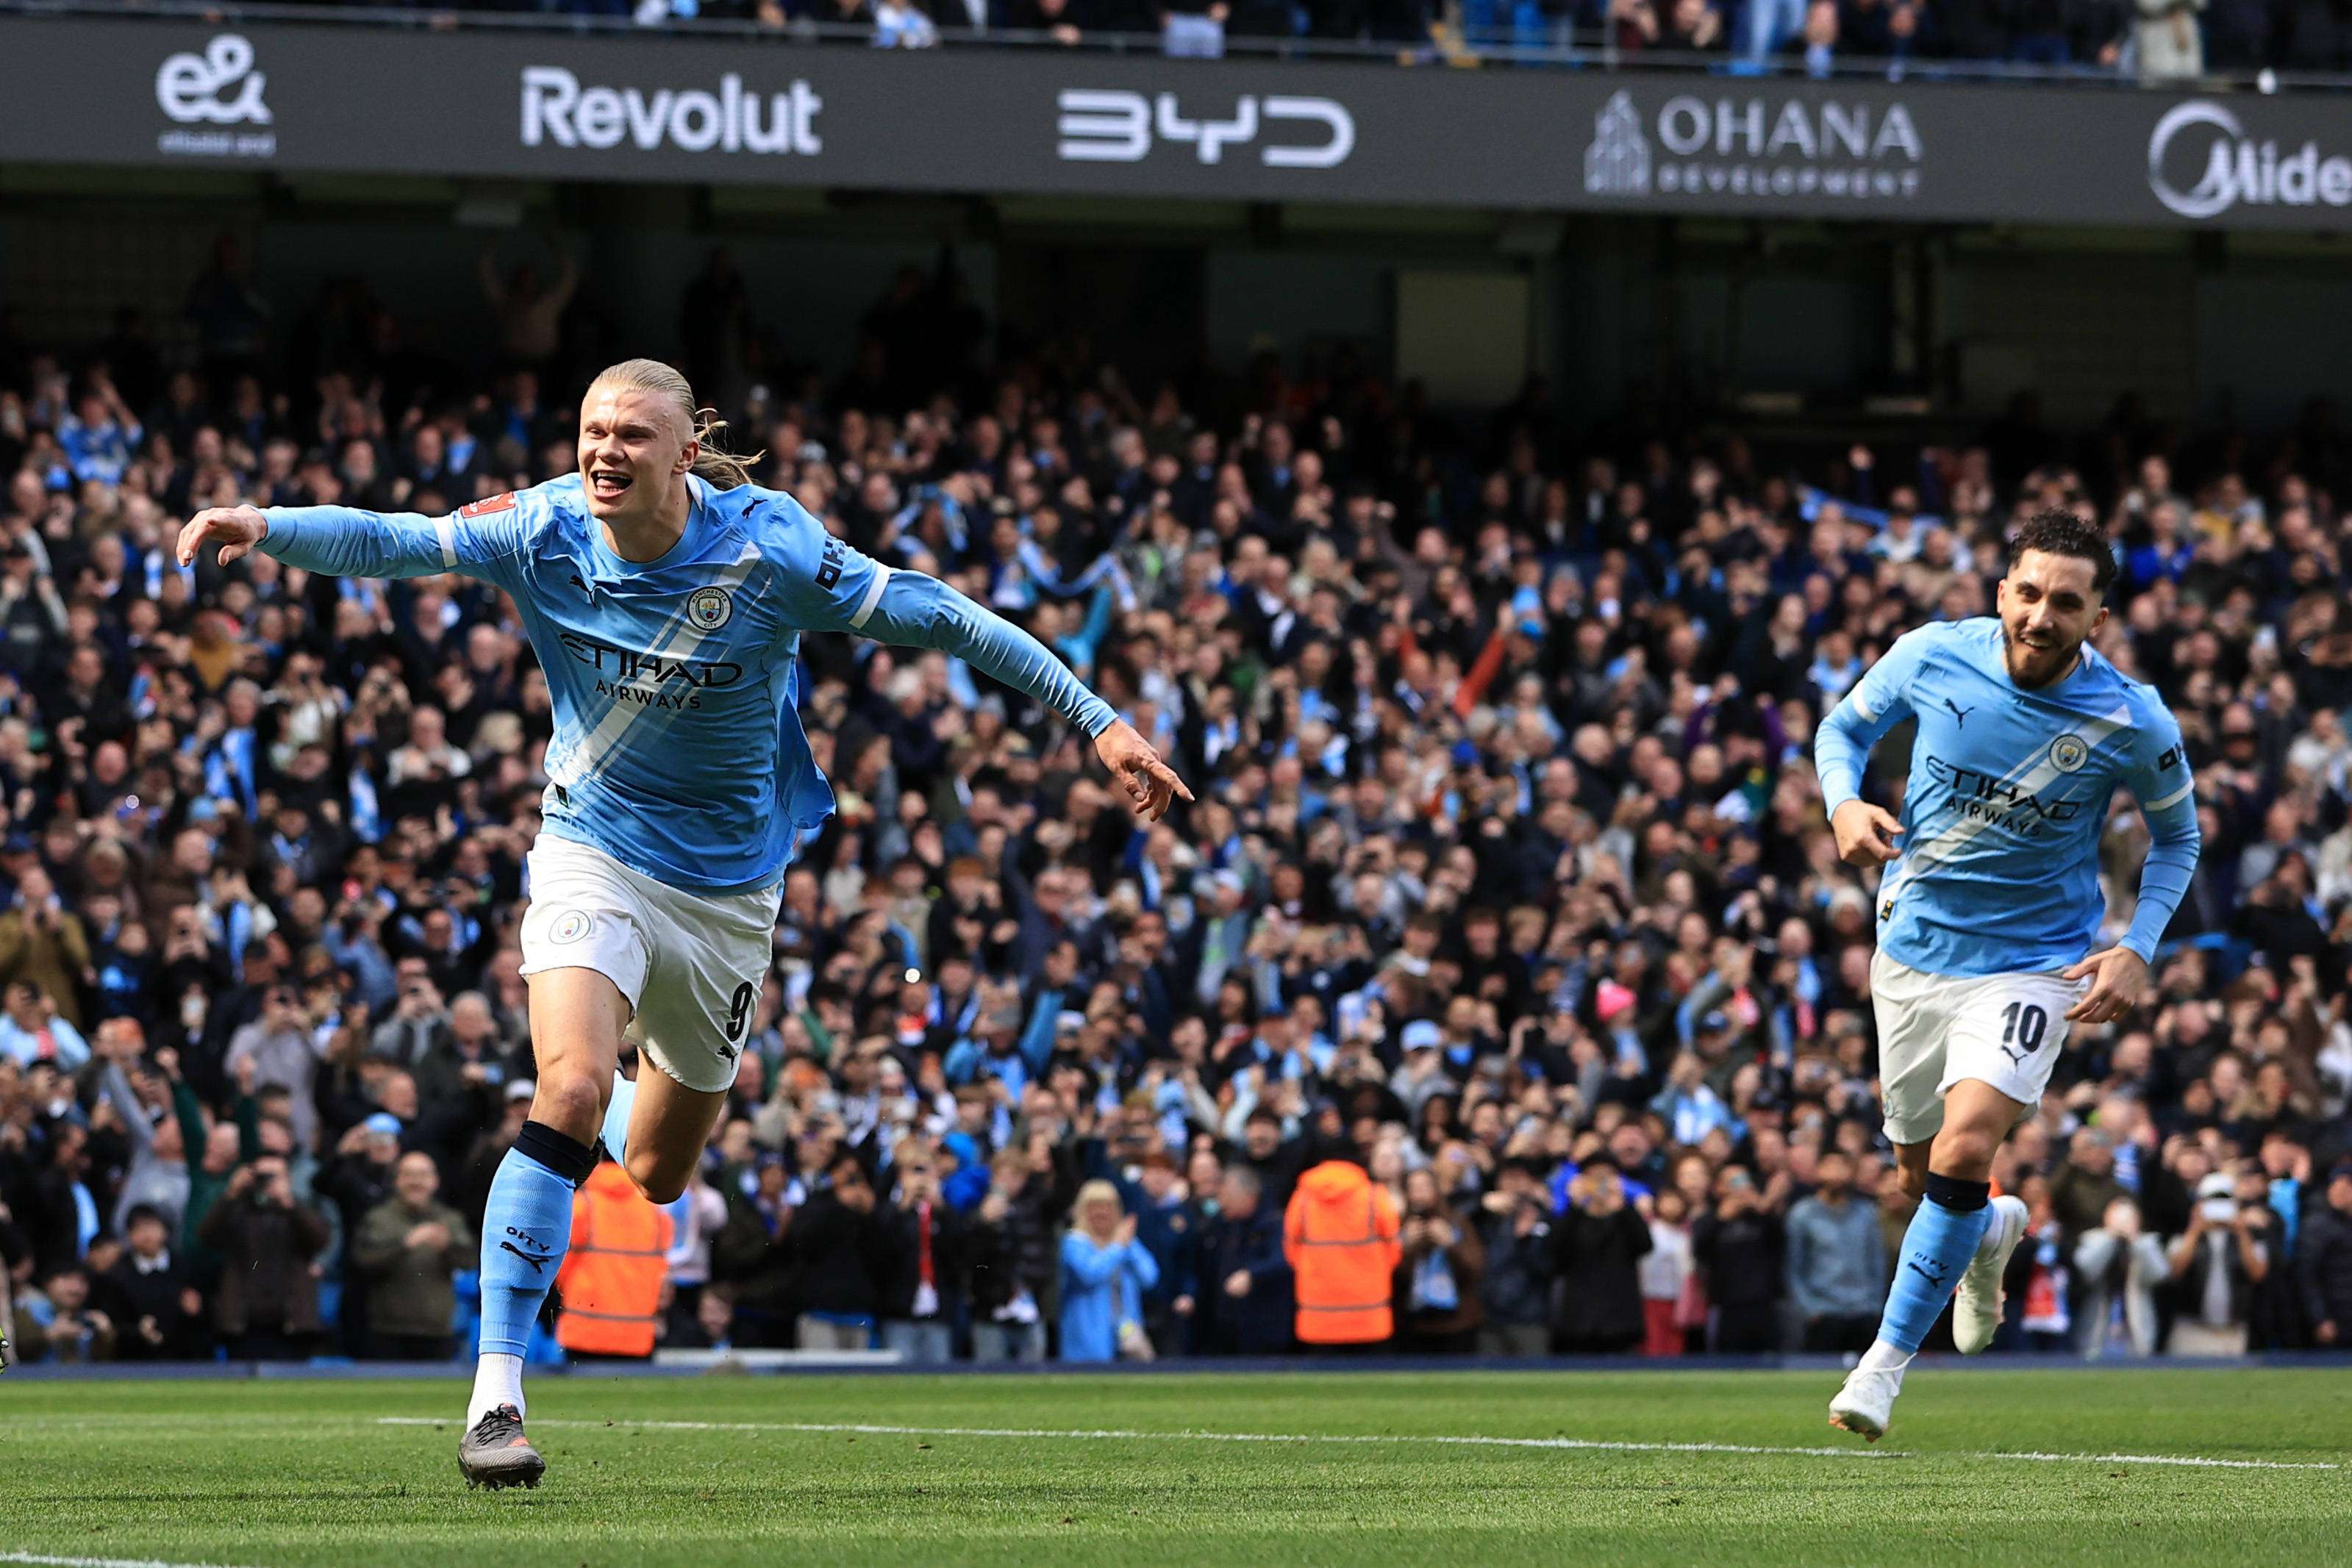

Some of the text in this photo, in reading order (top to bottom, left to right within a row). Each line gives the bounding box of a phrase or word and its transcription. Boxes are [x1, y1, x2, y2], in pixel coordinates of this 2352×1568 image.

[520, 65, 823, 156] Revolut
[1057, 88, 1356, 168] BYD
[1657, 96, 1924, 162] OHANA
[1657, 162, 1920, 198] DEVELOPMENT
[692, 590, 727, 604] MANCHESTER
[560, 634, 743, 687] ETIHAD
[596, 679, 701, 709] AIRWAYS
[1926, 755, 2081, 820] ETIHAD
[1945, 795, 2042, 837] AIRWAYS
[726, 981, 753, 1042] 9
[2001, 1001, 2047, 1053] 10
